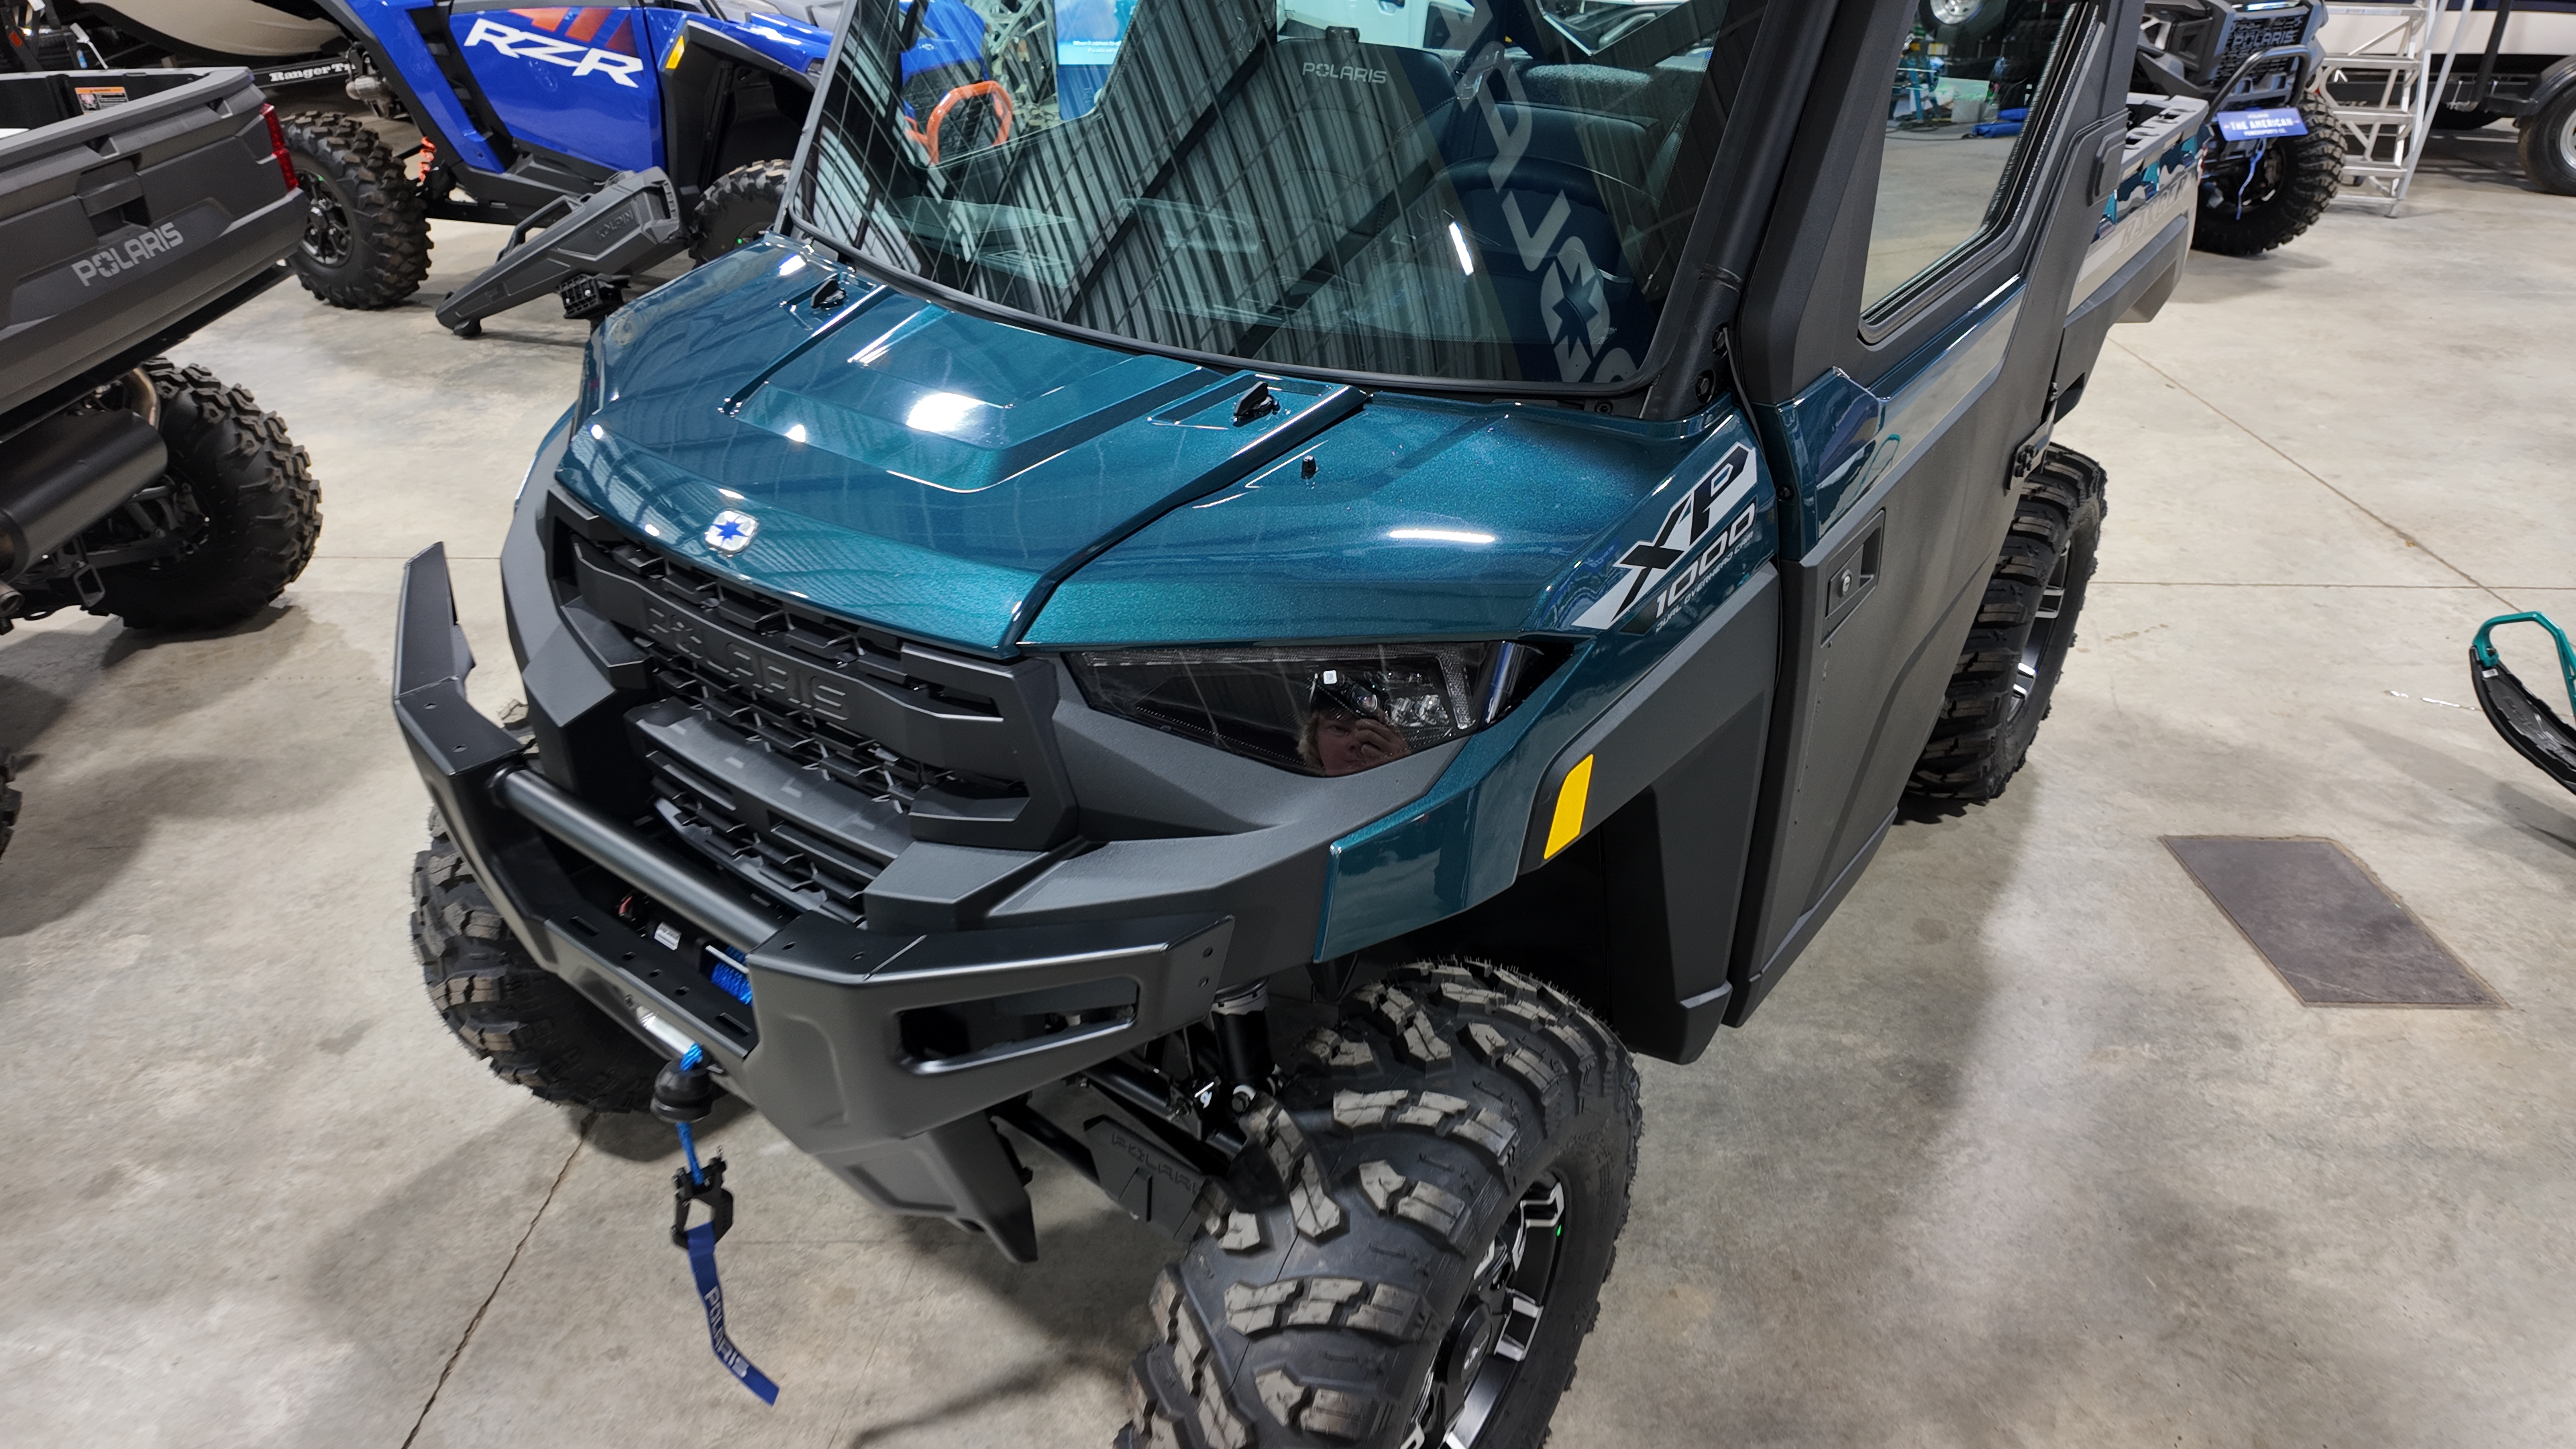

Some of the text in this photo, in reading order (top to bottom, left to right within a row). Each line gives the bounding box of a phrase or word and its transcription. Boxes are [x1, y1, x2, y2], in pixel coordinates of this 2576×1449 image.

[269, 65, 331, 82] Ranger
[464, 17, 644, 89] RZR
[1302, 62, 1387, 84] POLARIS
[2231, 30, 2294, 49] POLARIS
[2230, 118, 2294, 131] THE AMERICAN
[70, 221, 184, 286] POLARIS
[1609, 443, 1754, 627] XP
[1656, 503, 1756, 619] 1000
[1654, 604, 1682, 635] DUAL
[1684, 551, 1733, 604] OVERHEAD
[644, 600, 849, 722] POLARIS
[1111, 1131, 1197, 1195] POLARI
[704, 1285, 750, 1379] POLARIS
